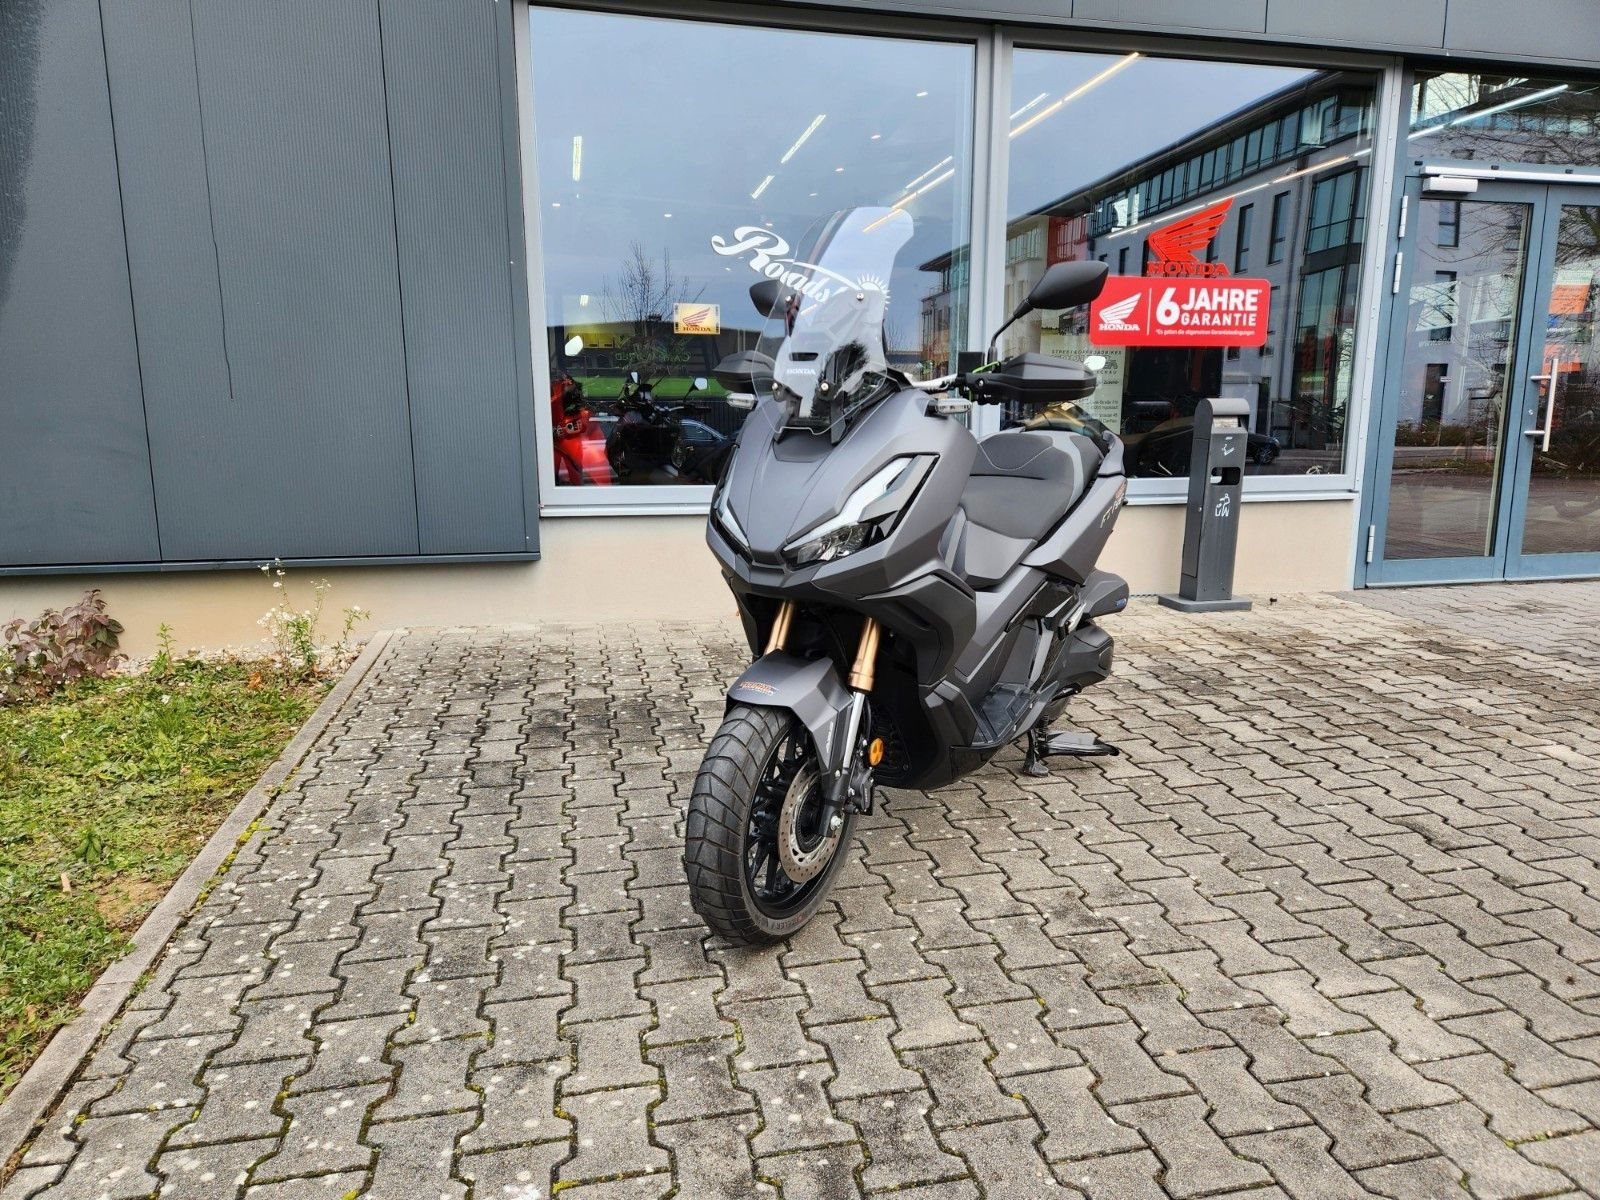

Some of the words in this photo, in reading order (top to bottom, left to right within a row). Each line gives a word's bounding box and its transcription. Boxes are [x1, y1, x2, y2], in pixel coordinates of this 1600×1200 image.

[1147, 261, 1231, 275] HONDA
[1155, 287, 1180, 326] 6
[1180, 312, 1257, 327] GARANTIE
[1098, 323, 1140, 331] HONDA
[786, 367, 816, 375] HONDA
